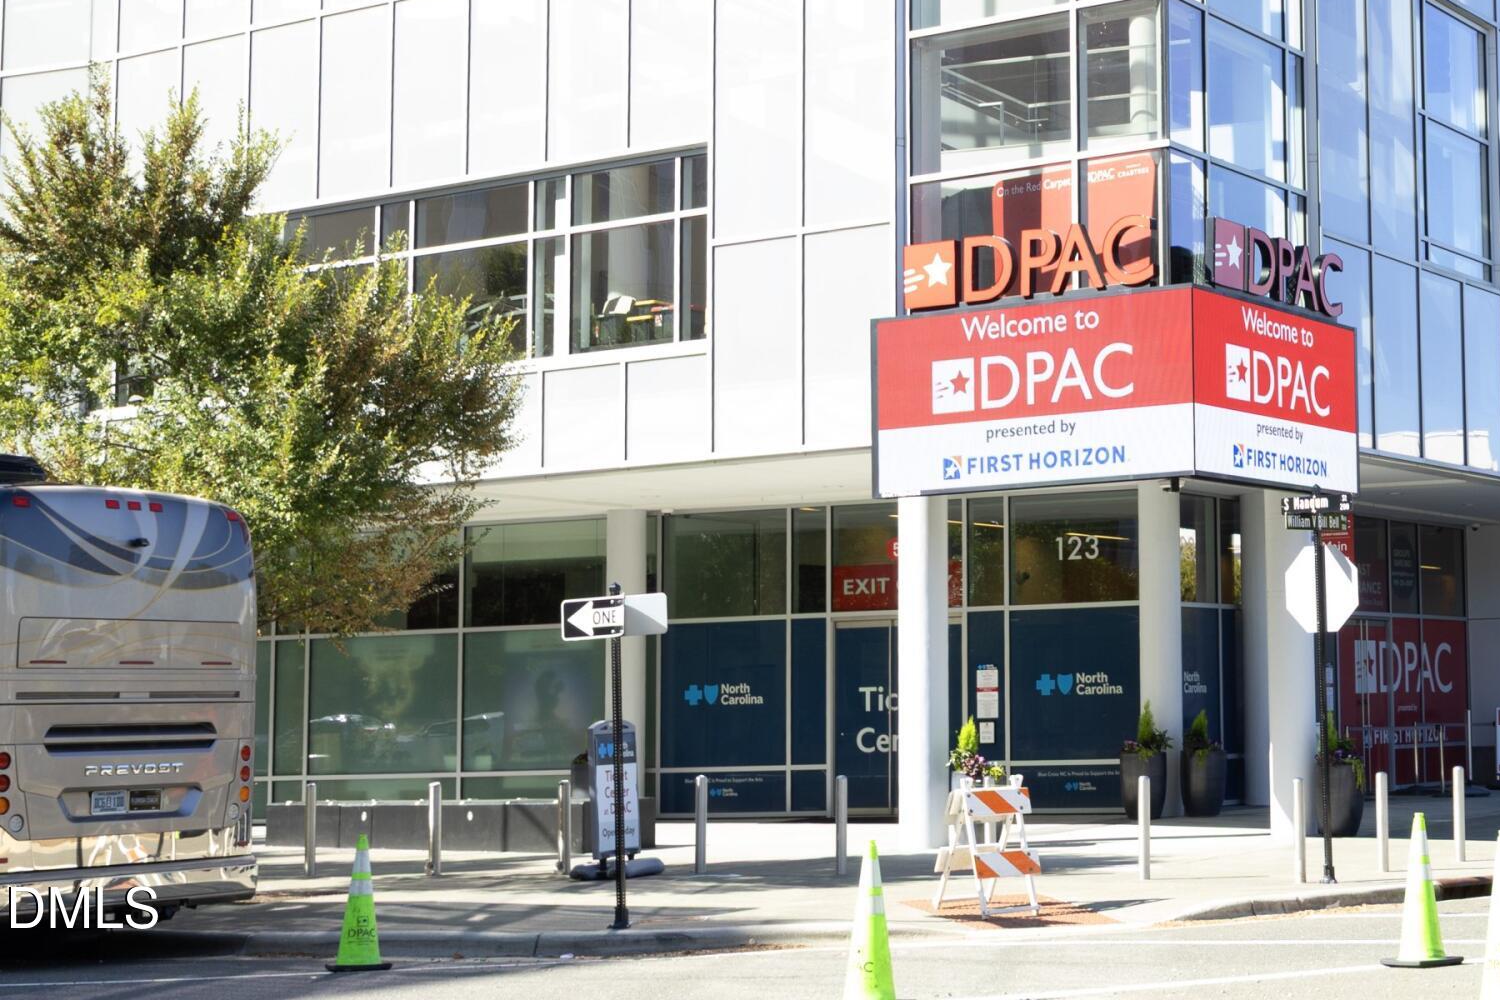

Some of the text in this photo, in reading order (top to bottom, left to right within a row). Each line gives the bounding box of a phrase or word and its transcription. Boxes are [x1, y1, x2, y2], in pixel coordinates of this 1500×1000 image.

[1011, 183, 1024, 195] the
[963, 213, 1158, 304] DPAC
[1249, 226, 1344, 317] DPAC
[960, 309, 1100, 342] Welcome to
[1241, 304, 1314, 349] Welcome to
[980, 341, 1135, 410] DPAC
[1252, 349, 1332, 418] DPAC
[985, 418, 1077, 443] presented by
[1256, 422, 1304, 443] presented by
[966, 444, 1127, 475] FIRST HORIZON
[1246, 447, 1327, 478] FIRST HORIZON
[1283, 496, 1290, 512] S
[1287, 514, 1311, 529] William
[1329, 514, 1340, 529] Bell
[1055, 535, 1100, 561] 123
[843, 577, 890, 596] EXIT
[592, 609, 617, 625] ONE
[1076, 671, 1109, 684] North
[1183, 671, 1200, 682] North
[1378, 641, 1453, 694] DPAC
[720, 683, 751, 694] North
[1076, 683, 1123, 695] Carolina
[1183, 682, 1208, 694] Carolina
[720, 694, 764, 706] Carolina
[858, 685, 899, 712] Tic
[84, 762, 184, 776] PREVOST
[347, 927, 376, 938] DPAC
